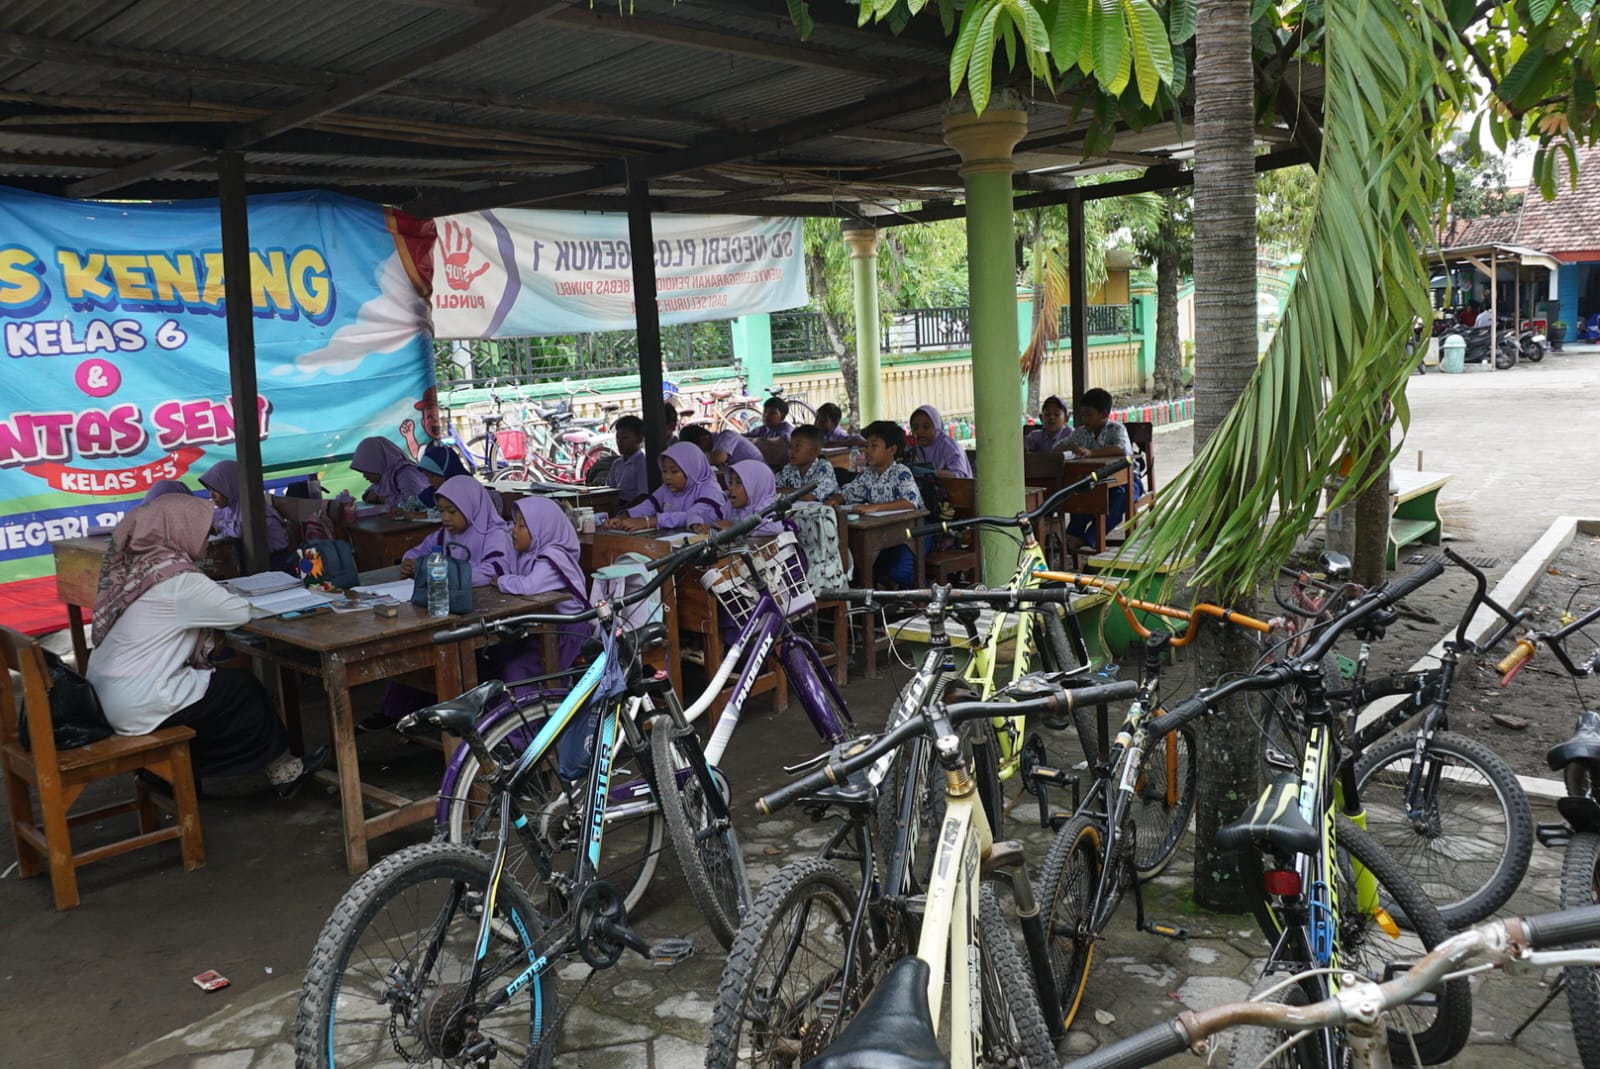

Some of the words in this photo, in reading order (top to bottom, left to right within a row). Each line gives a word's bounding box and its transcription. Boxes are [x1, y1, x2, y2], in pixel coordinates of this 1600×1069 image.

[6, 321, 143, 356] KELAS
[156, 321, 186, 349] 6
[87, 366, 108, 388] &
[61, 471, 137, 491] KELAS
[142, 464, 177, 484] 1-5
[735, 631, 773, 711] PHOENIX
[591, 743, 612, 843] FOSTER
[506, 955, 548, 998] FOSTER
